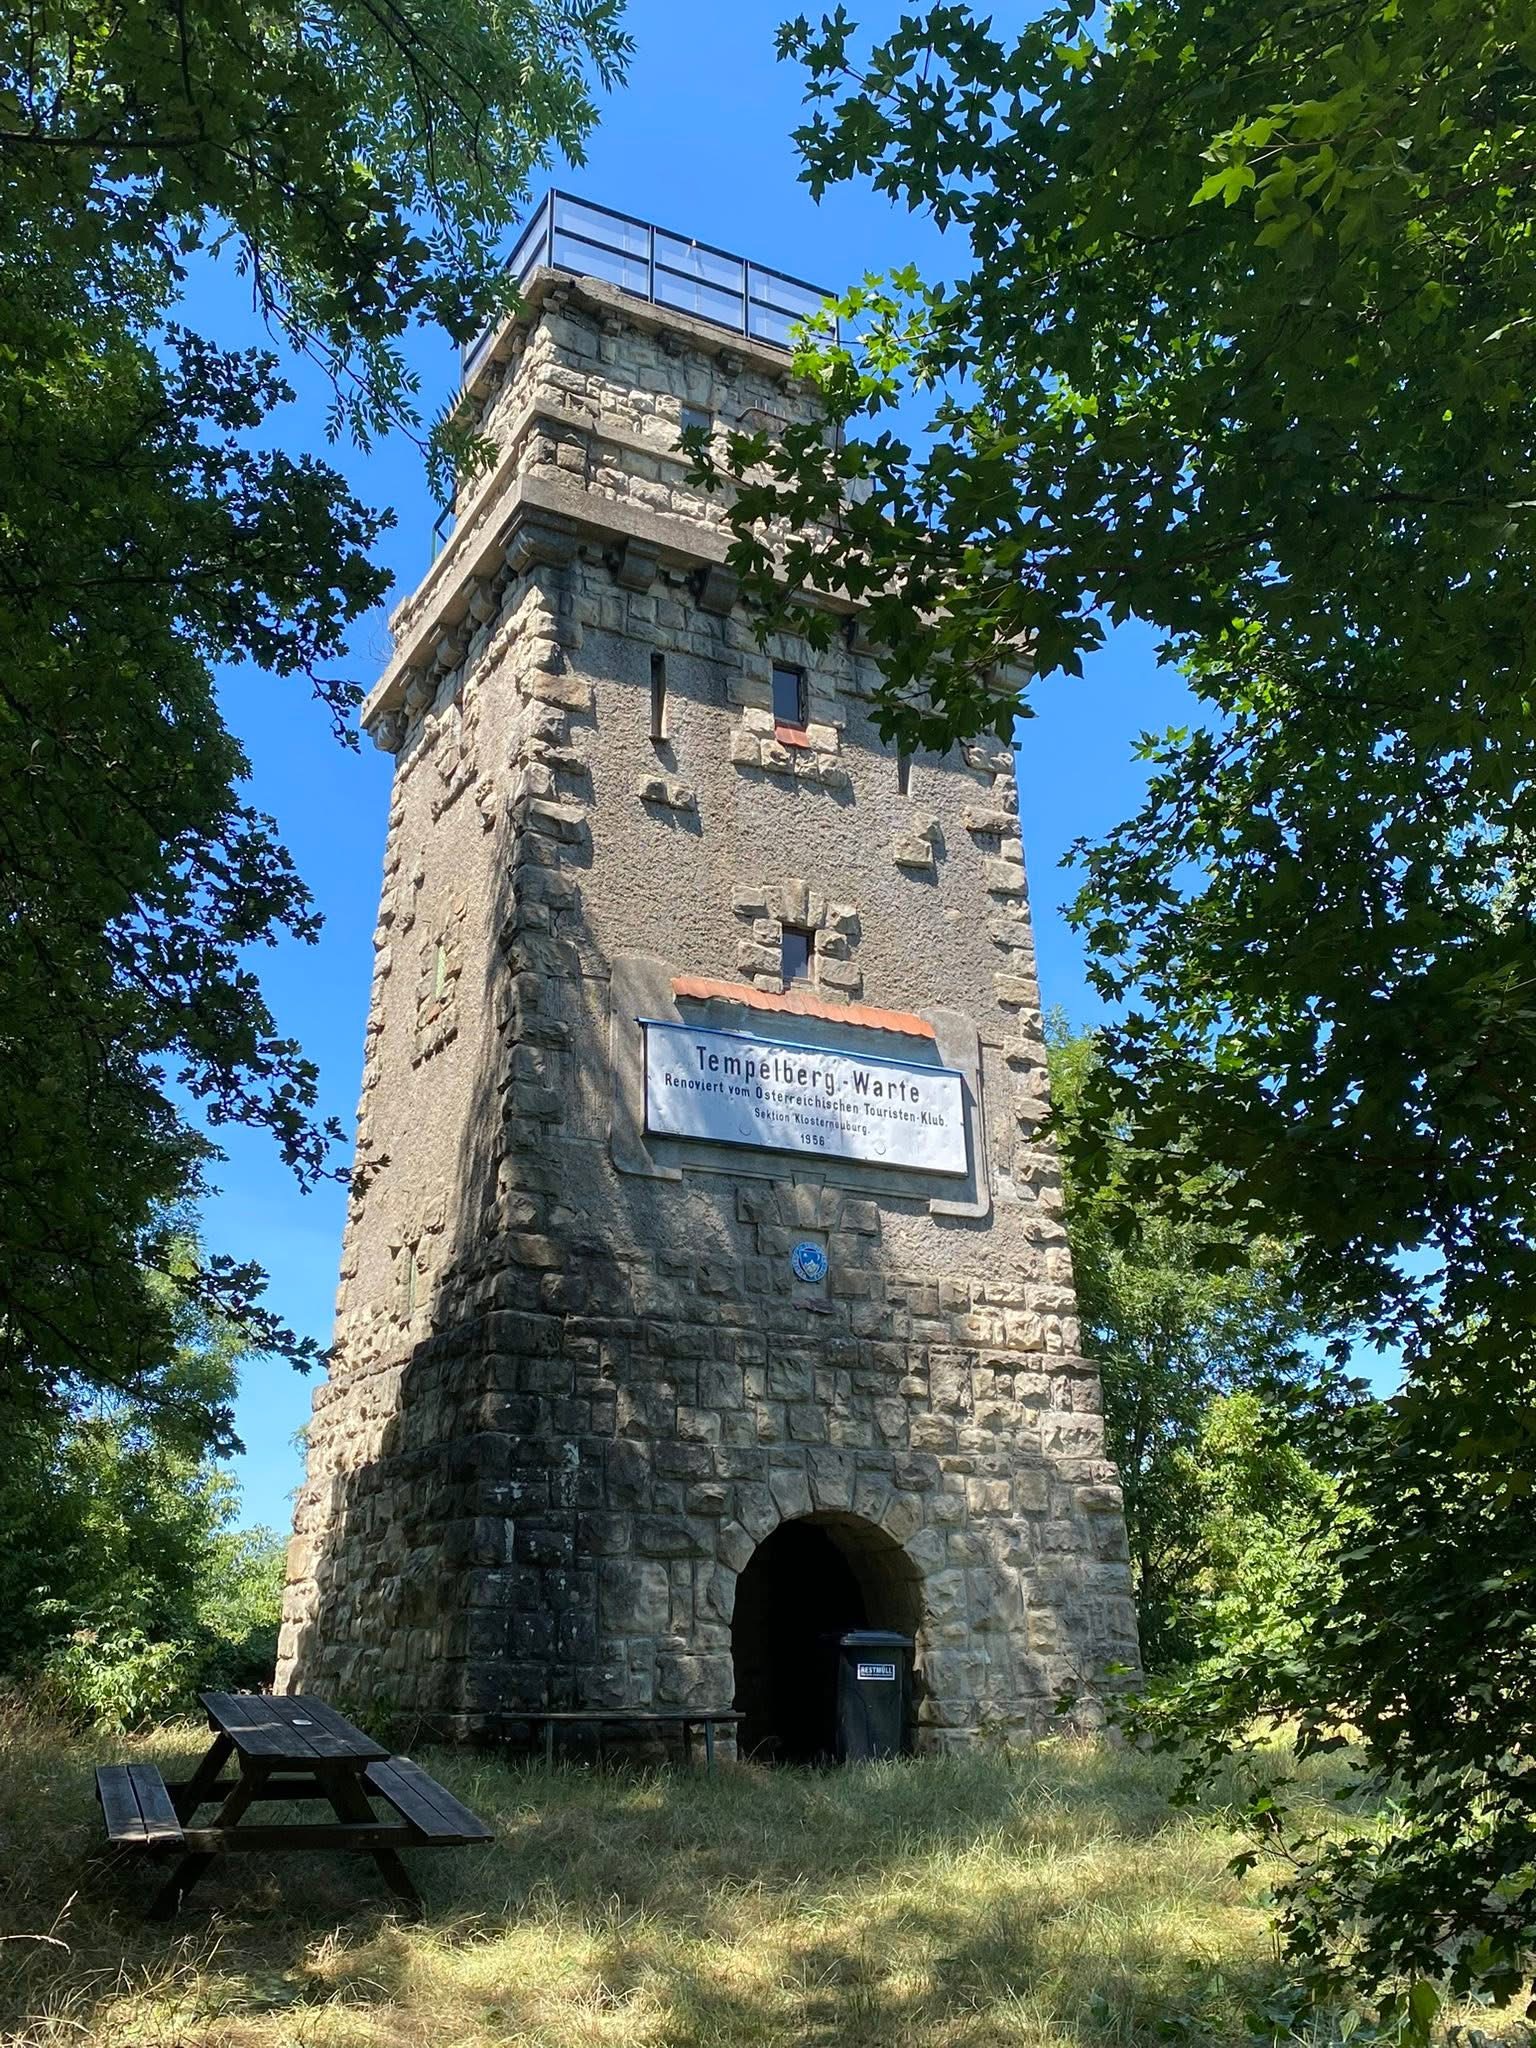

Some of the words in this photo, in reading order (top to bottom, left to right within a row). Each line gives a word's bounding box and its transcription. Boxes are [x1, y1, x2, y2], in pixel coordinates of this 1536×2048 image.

[665, 1072, 724, 1093] Renoviert
[728, 1084, 750, 1097] vom
[754, 1107, 790, 1122] Sektion
[800, 1133, 825, 1146] 1956
